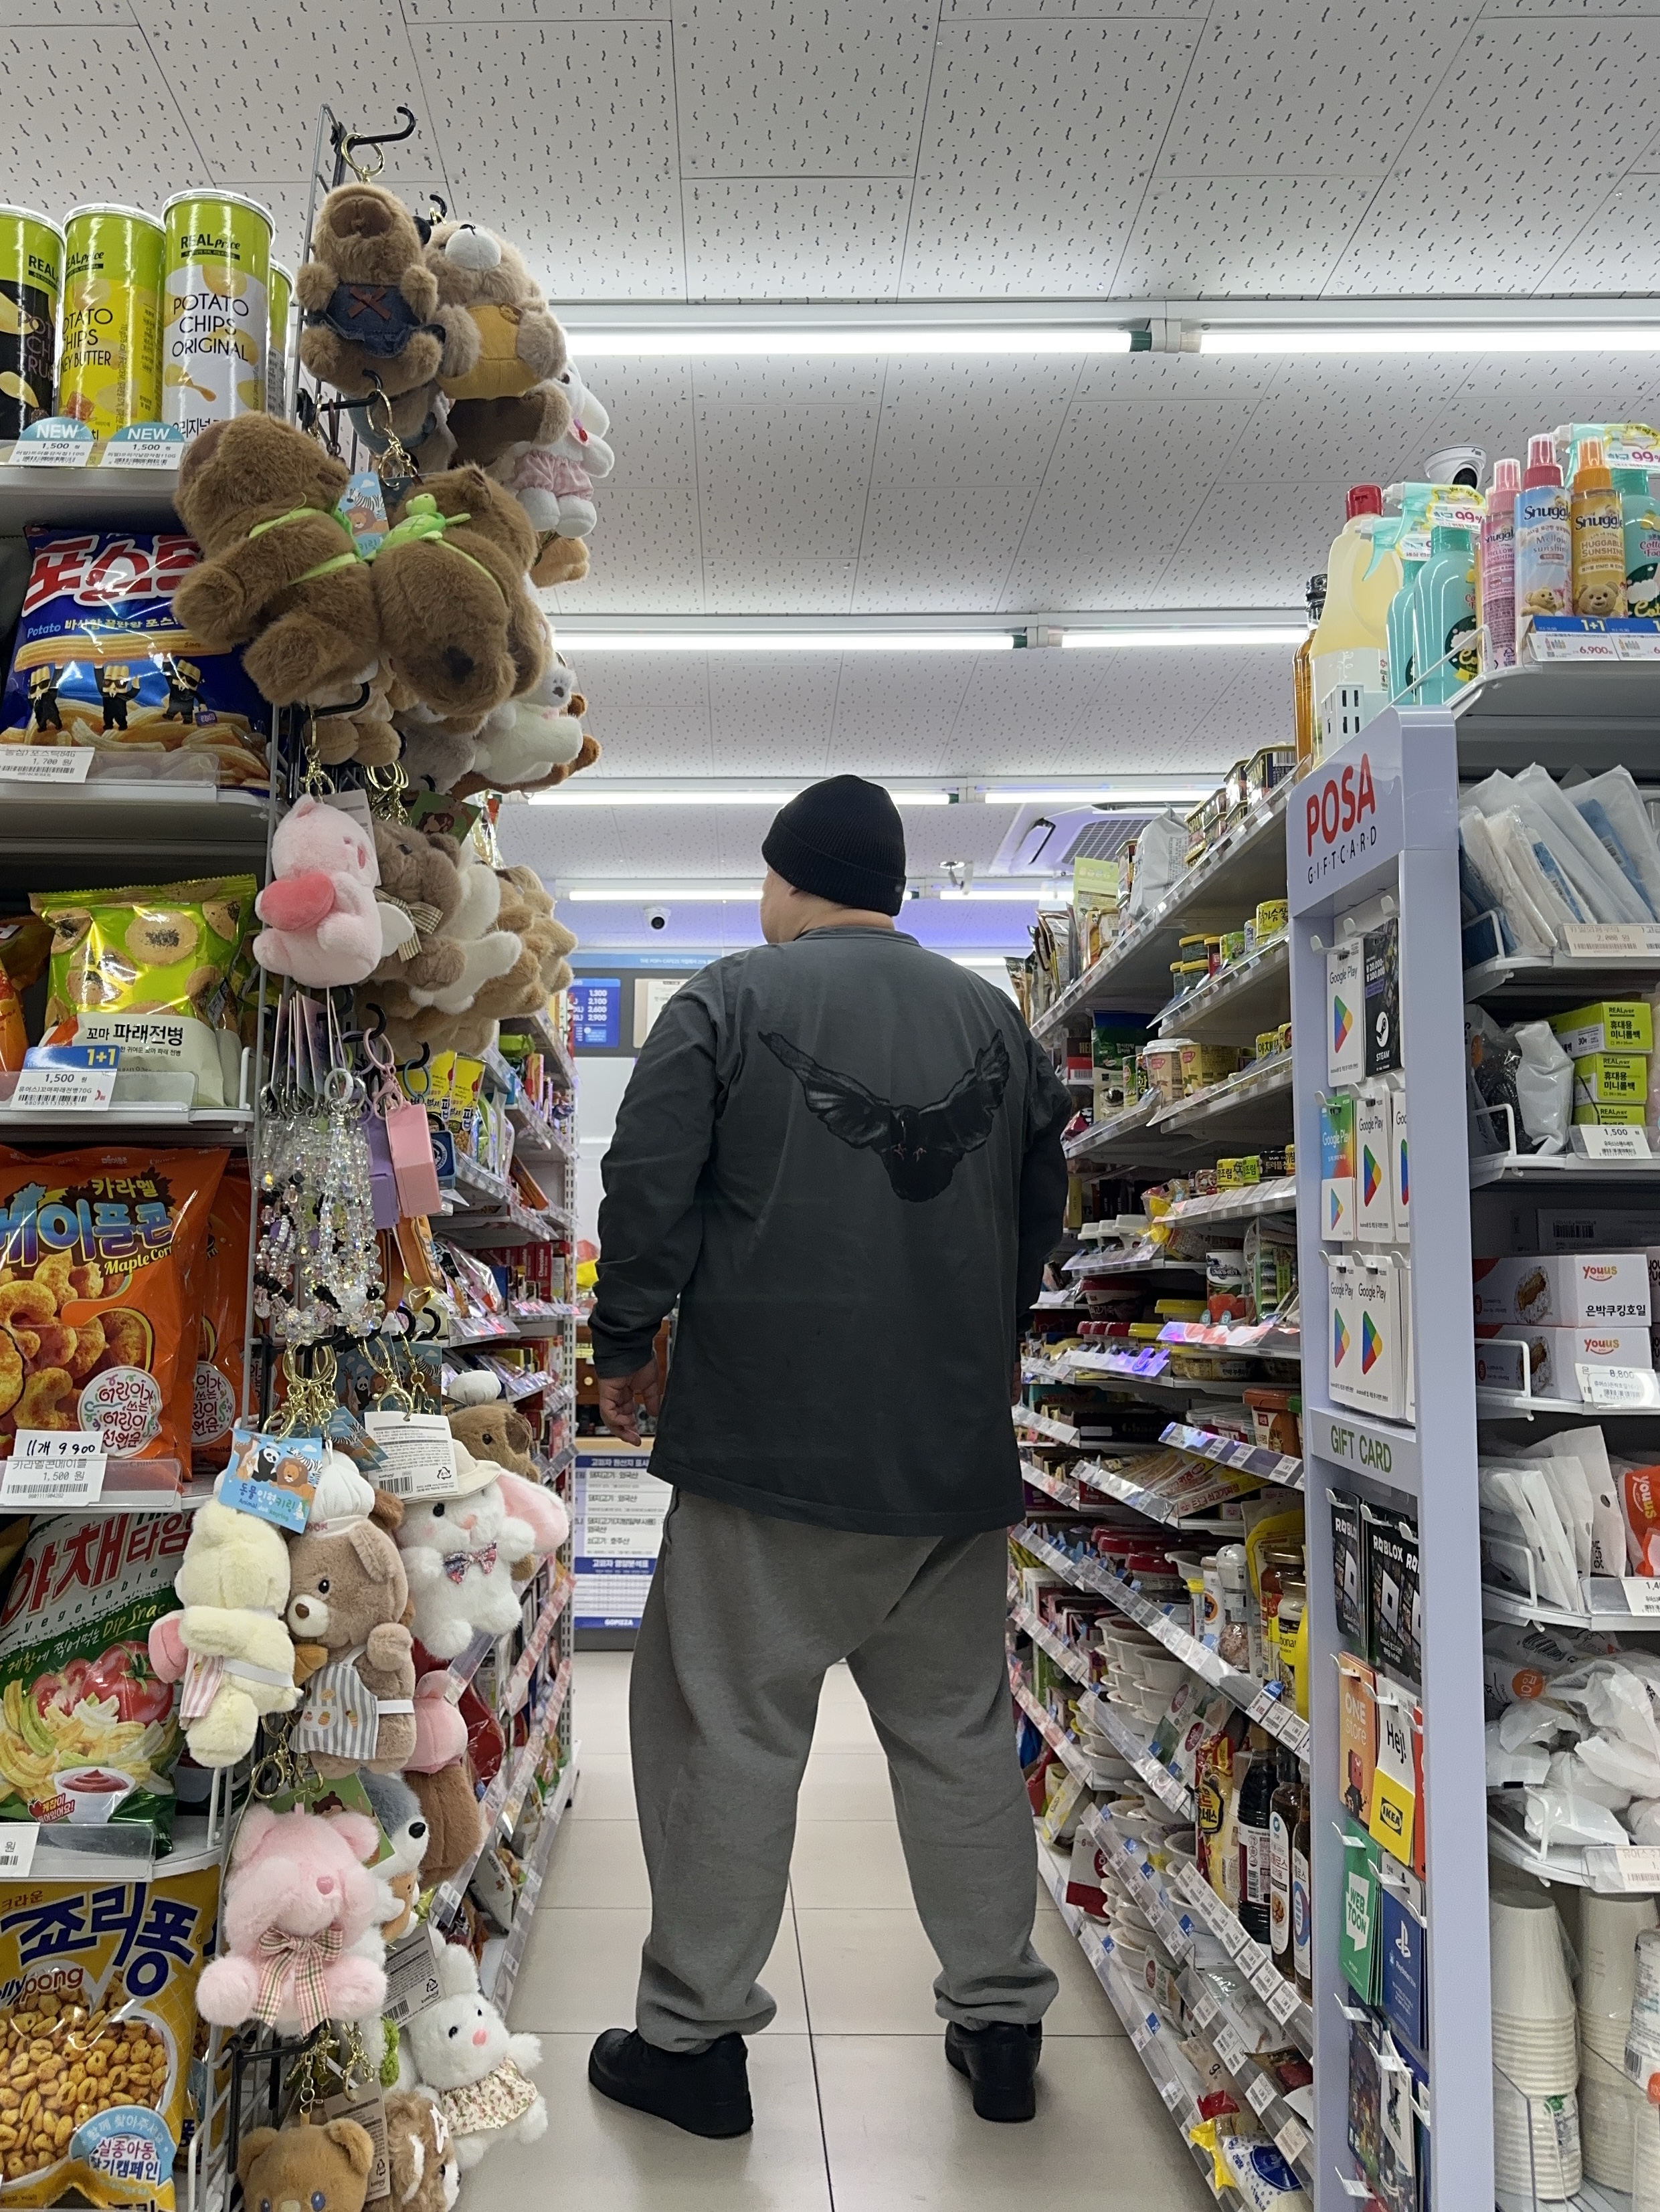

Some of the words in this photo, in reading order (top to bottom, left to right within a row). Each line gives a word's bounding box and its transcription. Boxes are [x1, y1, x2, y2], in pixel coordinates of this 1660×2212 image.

[173, 293, 250, 317] POTATO
[17, 310, 54, 339] POT
[179, 316, 238, 336] CHIPS
[63, 328, 98, 355] HIPS
[172, 338, 249, 363] ORIGINAL
[74, 350, 111, 368] BUTTER
[36, 424, 79, 439] NEW
[127, 427, 171, 441] NEW
[1574, 514, 1624, 531] Snuggle
[27, 622, 62, 638] Potato
[1580, 619, 1606, 631] 1+1
[1579, 646, 1608, 655] 6,900
[33, 758, 58, 766] 1,700
[1307, 752, 1376, 857] POSA
[1329, 967, 1347, 985] Google
[1347, 965, 1358, 979] Play
[86, 1027, 110, 1041] 꼬마
[113, 1023, 183, 1046] 파래전병
[1610, 1020, 1633, 1030] 휴대용
[1610, 1030, 1641, 1040] 미니롤백
[86, 1048, 116, 1067] 1+1
[1376, 1049, 1390, 1062] STEAM
[44, 1074, 75, 1084] 1,500
[1604, 1072, 1628, 1081] 휴대용
[1604, 1081, 1636, 1092] 미니롤백
[1359, 1116, 1374, 1134] Google
[1374, 1116, 1384, 1132] Play
[1322, 1131, 1340, 1148] Google
[92, 1177, 158, 1197] 카라멜
[104, 1255, 150, 1276] Maple
[1330, 1282, 1345, 1299] Google
[1345, 1283, 1354, 1300] Play
[1358, 1283, 1376, 1302] Google
[1376, 1285, 1387, 1303] Play
[1585, 1304, 1647, 1317] 은박쿠킹호일
[98, 1381, 154, 1405] 어린이가
[102, 1411, 147, 1432] 어린이
[1330, 1425, 1354, 1460] GIFT
[1359, 1434, 1392, 1474] CARD
[43, 1472, 70, 1482] 1,500
[74, 1471, 86, 1482] 원
[239, 1482, 296, 1513] 동물인형키링
[1372, 1534, 1404, 1563] ROBLOX
[1345, 1692, 1366, 1726] ONE
[1345, 1718, 1368, 1746] store
[1386, 1720, 1407, 1765] Hej!
[1382, 1805, 1402, 1827] IKEA
[5, 1841, 16, 1853] 원
[1, 1890, 44, 1912] 크라운
[1350, 1886, 1365, 1916] WEB
[1348, 1900, 1367, 1936] TOON
[0, 1882, 199, 1997] 죠리퐁
[98, 2138, 155, 2161] 실종아동
